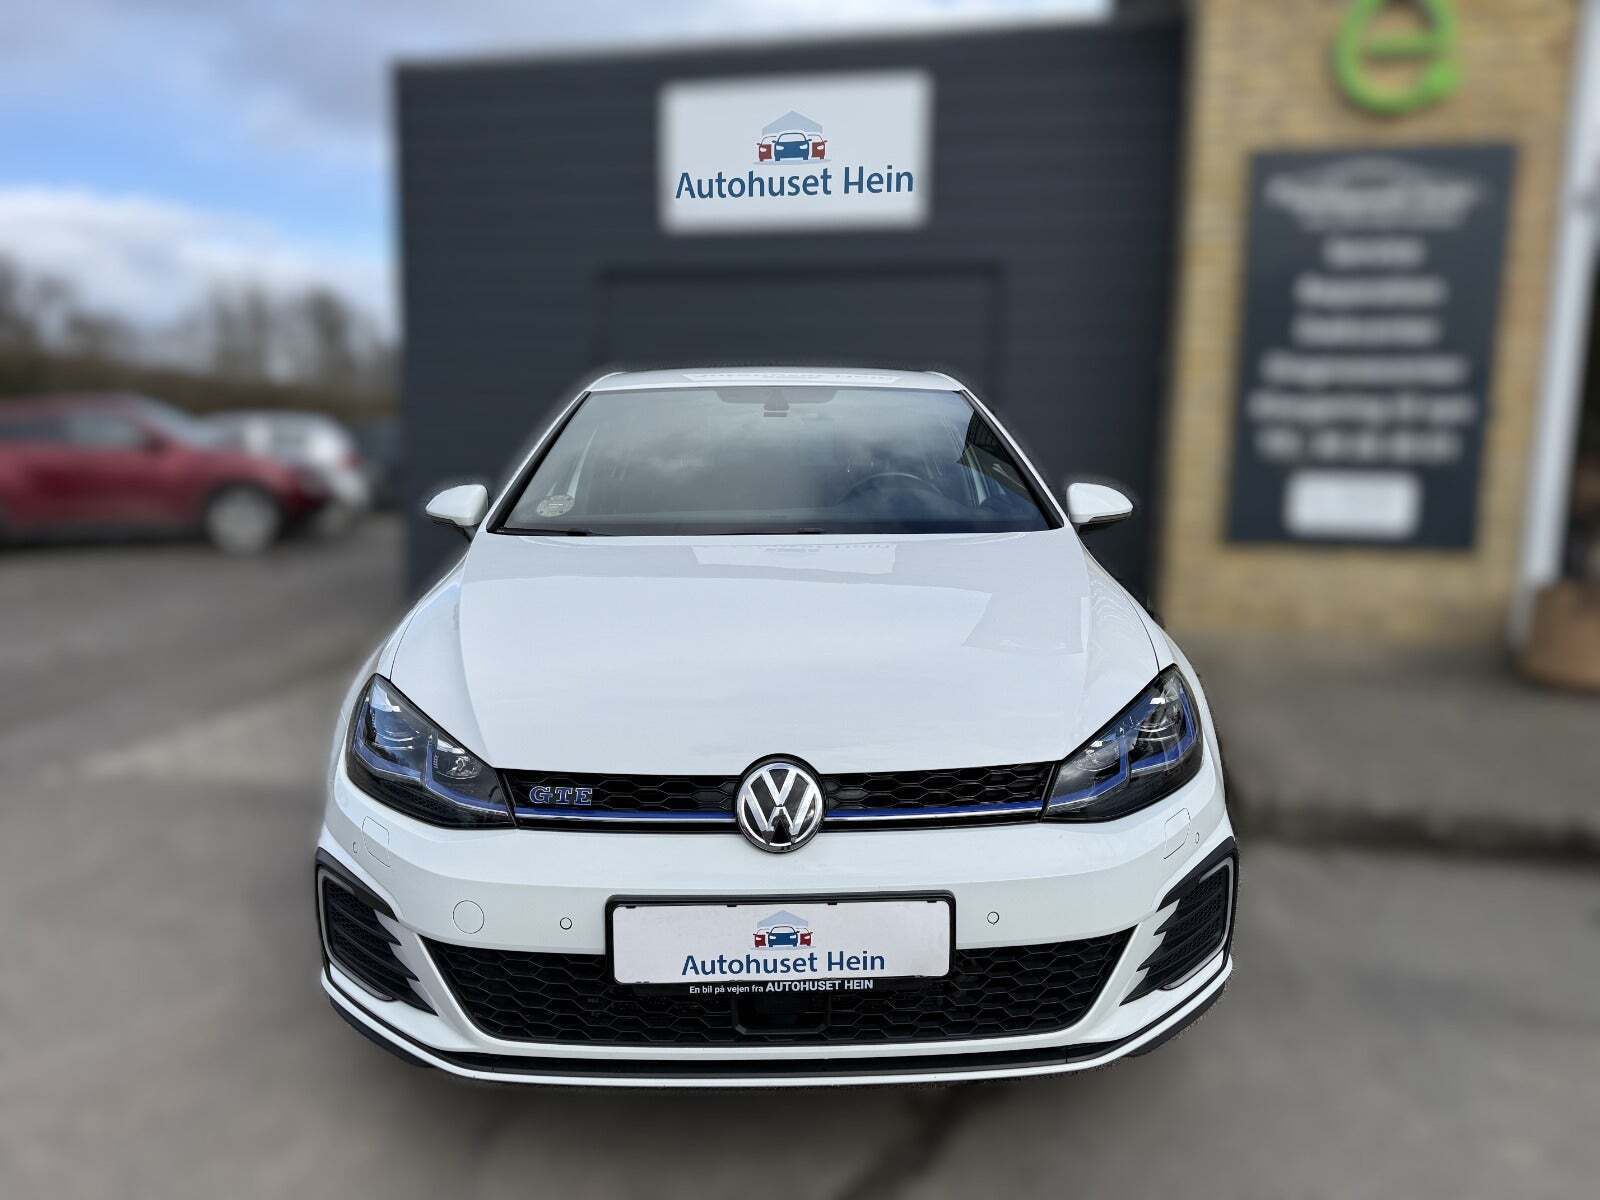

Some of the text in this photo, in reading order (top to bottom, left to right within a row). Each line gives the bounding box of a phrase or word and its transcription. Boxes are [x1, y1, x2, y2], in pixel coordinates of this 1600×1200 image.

[675, 165, 914, 199] Autohuset Hein
[528, 785, 593, 807] GTE
[681, 950, 886, 976] Autohuset Hein
[689, 979, 874, 995] En bil på vejen fra AUTOHUSET HEIN
